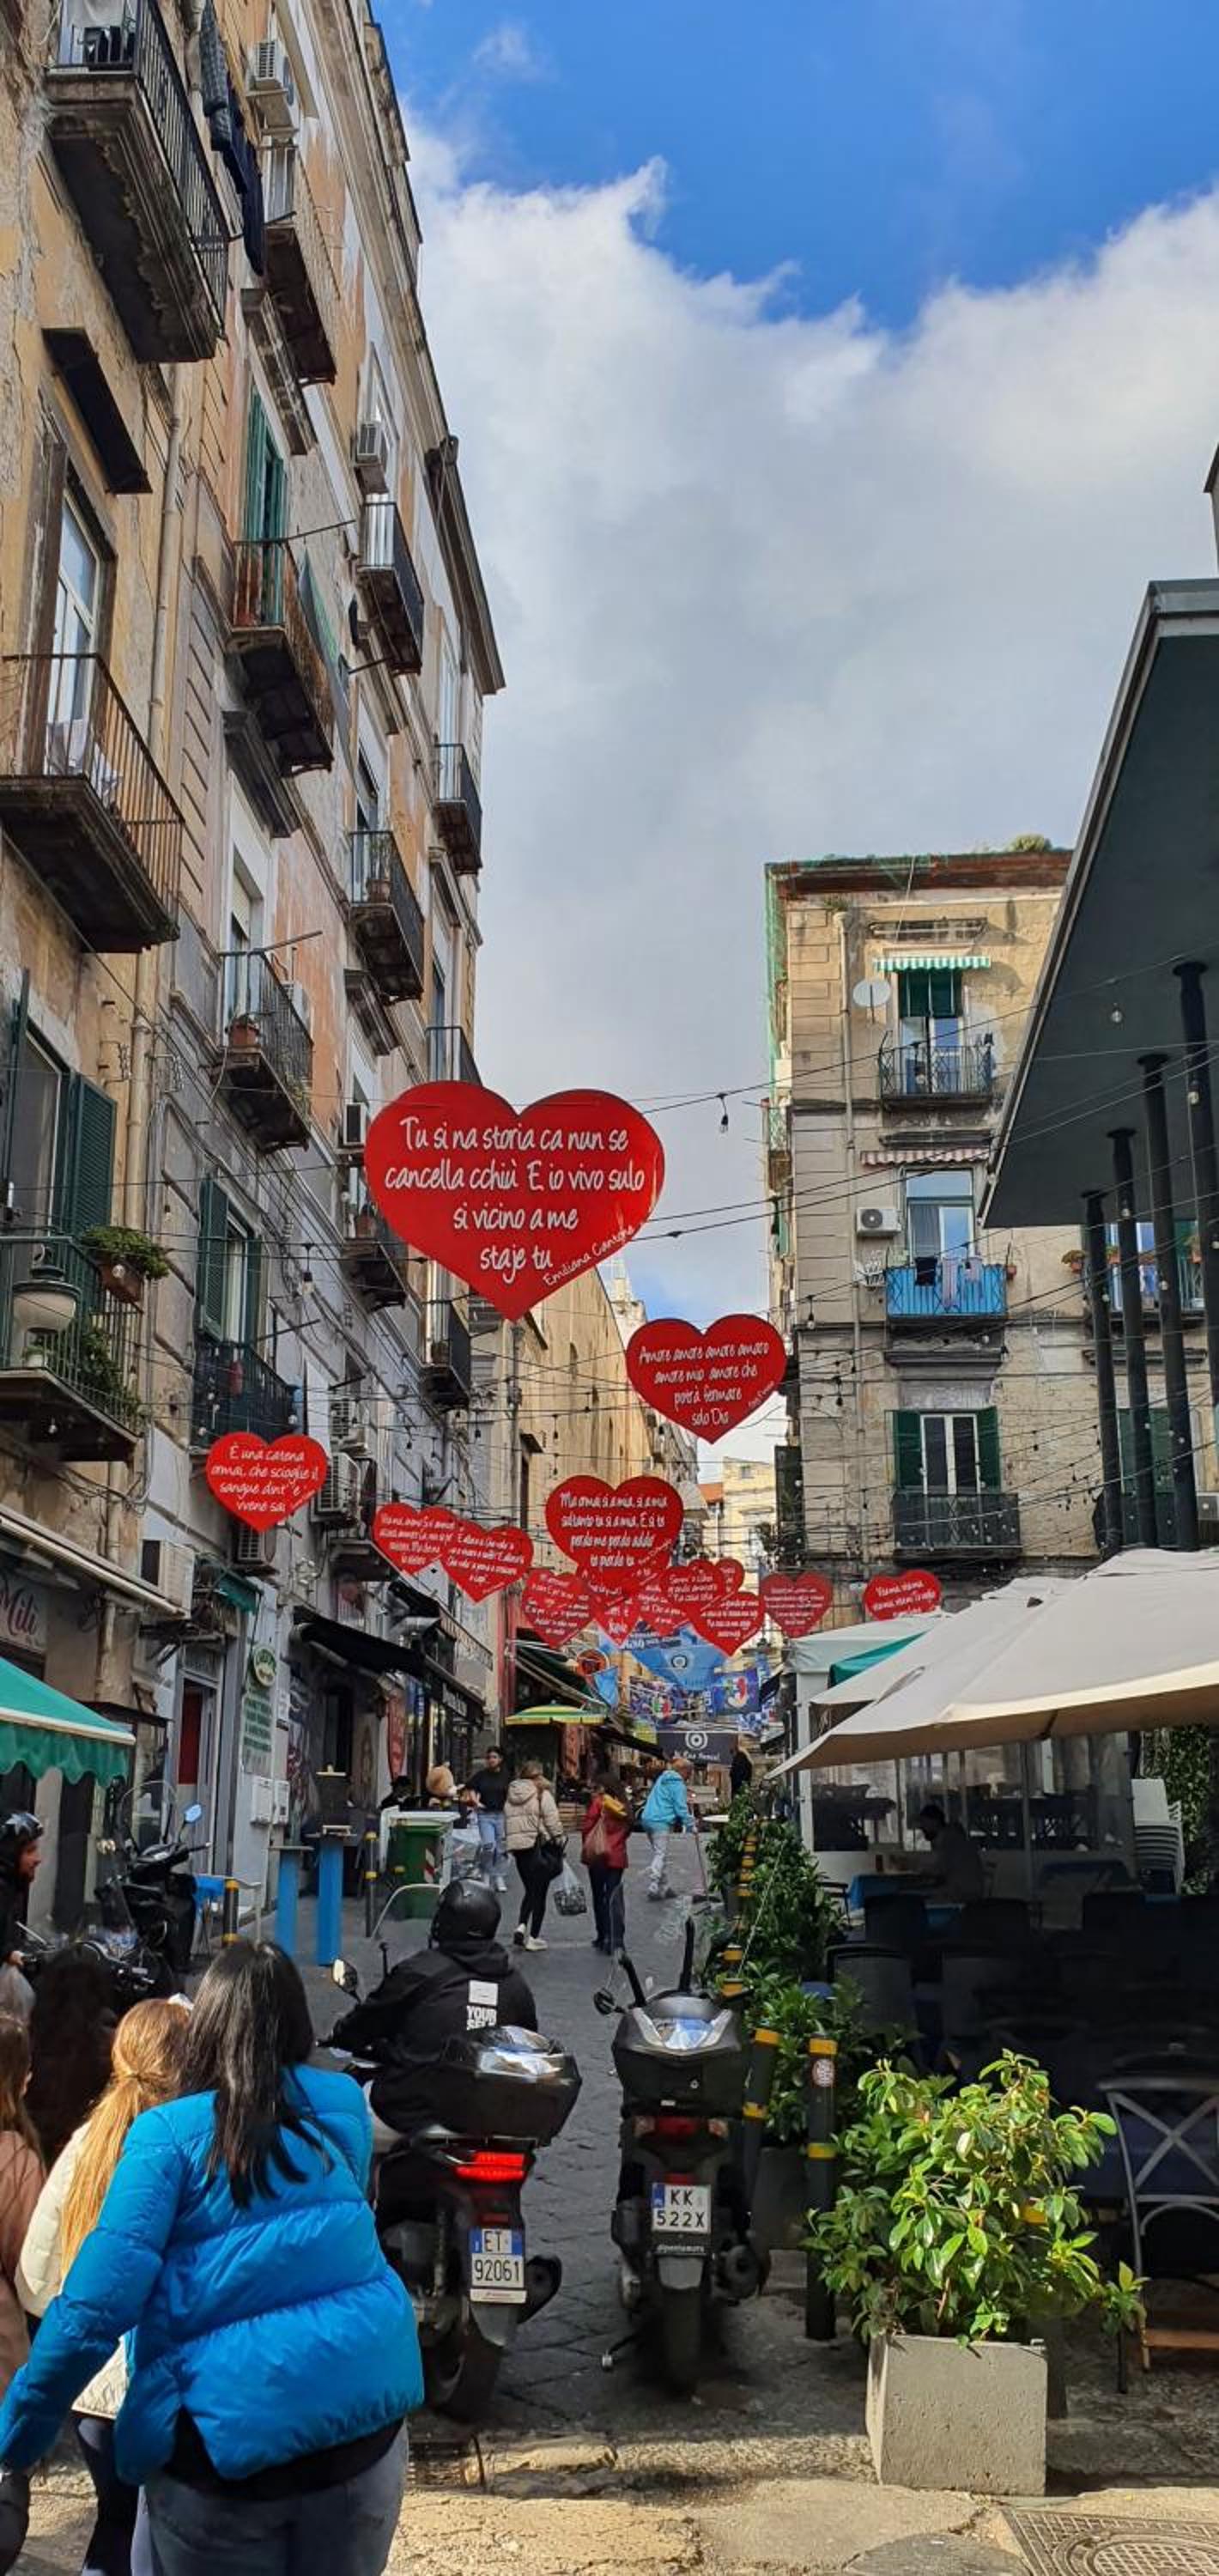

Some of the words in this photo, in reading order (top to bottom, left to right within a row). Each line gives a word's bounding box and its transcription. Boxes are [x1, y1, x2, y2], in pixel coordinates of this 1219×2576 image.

[399, 1116, 429, 1151] Tu
[434, 1121, 447, 1149] si
[452, 1130, 478, 1150] na
[482, 1121, 536, 1150] storia
[540, 1130, 563, 1151] ca
[567, 1130, 604, 1151] nun
[608, 1128, 628, 1152] se
[385, 1158, 464, 1191] cancella
[470, 1158, 518, 1190] cchiù
[527, 1160, 544, 1191] E
[549, 1163, 563, 1191] io
[567, 1163, 604, 1190] vivo
[608, 1159, 645, 1191] sulo
[453, 1202, 469, 1230] si
[472, 1202, 525, 1230] vicino
[530, 1210, 544, 1228] a
[547, 1206, 579, 1230] me
[480, 1244, 527, 1284] staje
[531, 1244, 553, 1269] tu
[639, 1346, 671, 1365] Amore
[673, 1346, 703, 1361] amore
[706, 1344, 736, 1358] amore
[654, 1369, 685, 1384] amore
[687, 1368, 704, 1381] mio
[709, 1365, 740, 1381] amore
[742, 1359, 758, 1377] che
[704, 1384, 742, 1402] fermare
[692, 1408, 710, 1425] solo
[711, 1407, 729, 1425] Dio
[241, 1450, 264, 1461] una
[265, 1450, 305, 1461] catena
[248, 1462, 268, 1478] che
[270, 1465, 310, 1486] scioglie
[312, 1465, 319, 1481] il
[219, 1482, 260, 1499] sangue
[270, 1501, 286, 1512] sai
[466, 2005, 497, 2026] YOUR
[670, 2190, 693, 2206] KK
[657, 2210, 705, 2227] 522X
[484, 2230, 502, 2251] ET
[474, 2259, 519, 2281] 92061
